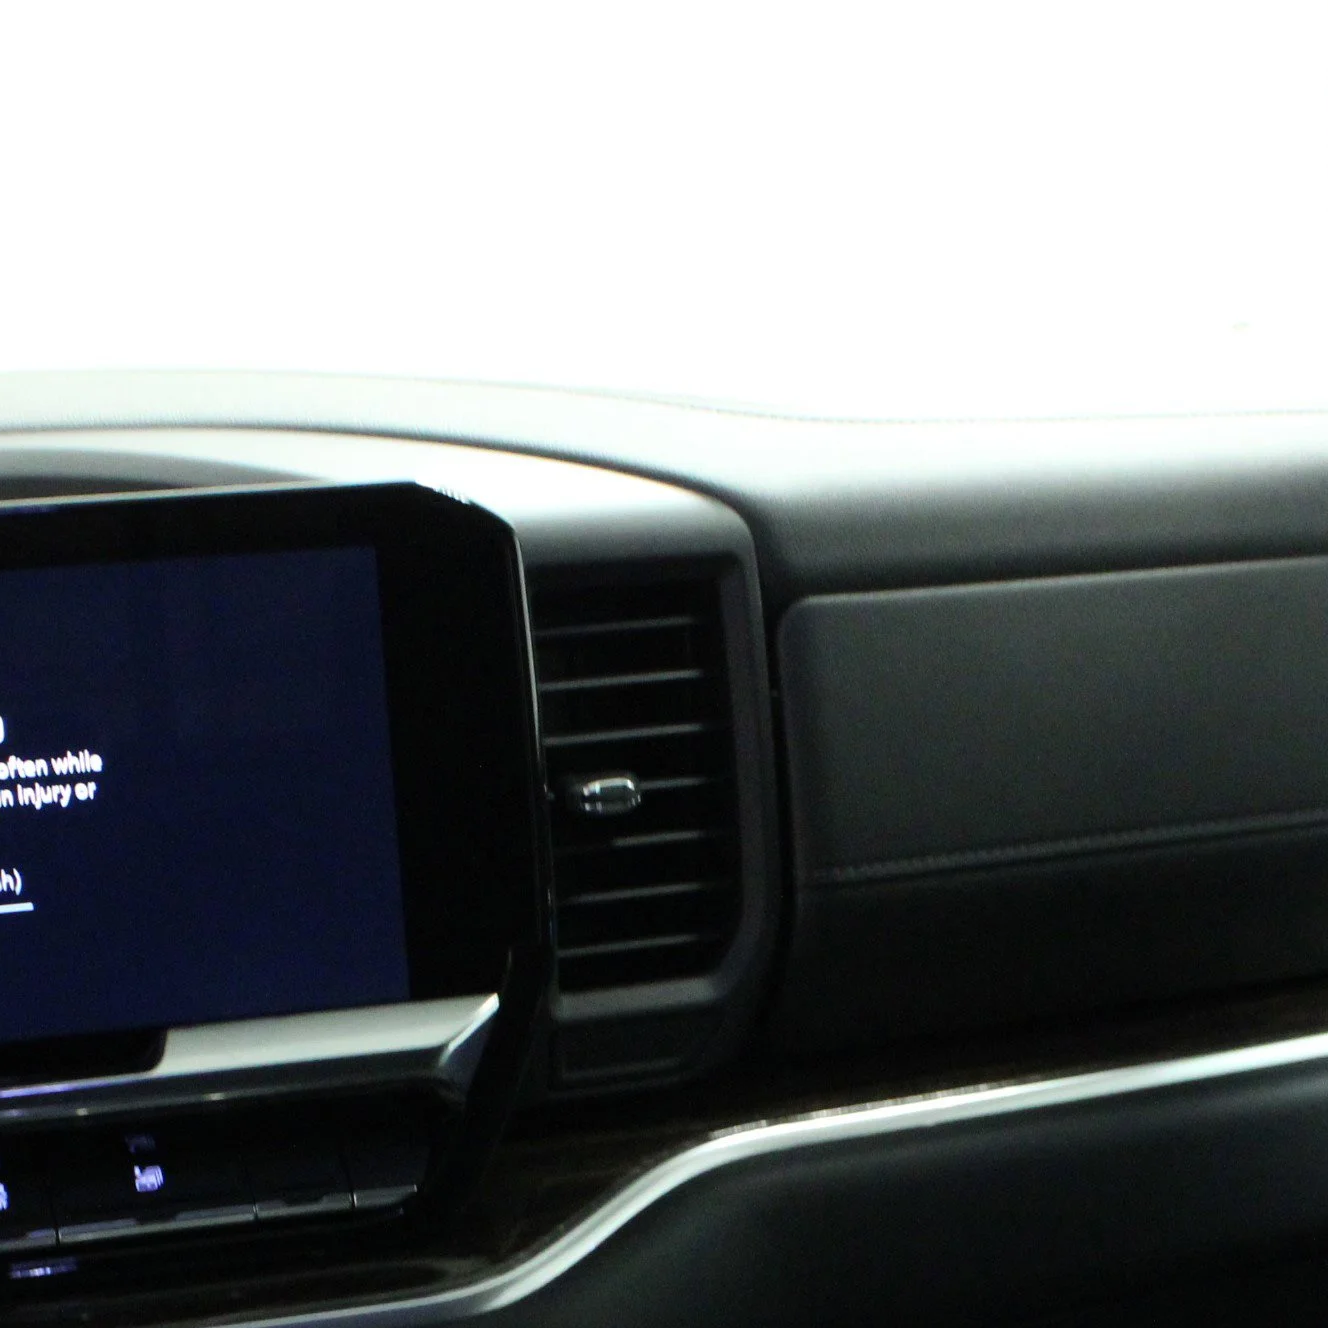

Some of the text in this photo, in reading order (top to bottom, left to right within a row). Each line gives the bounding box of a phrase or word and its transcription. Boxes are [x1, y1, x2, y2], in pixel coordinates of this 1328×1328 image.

[51, 749, 102, 775] while
[17, 781, 71, 810] injury
[74, 781, 97, 801] or
